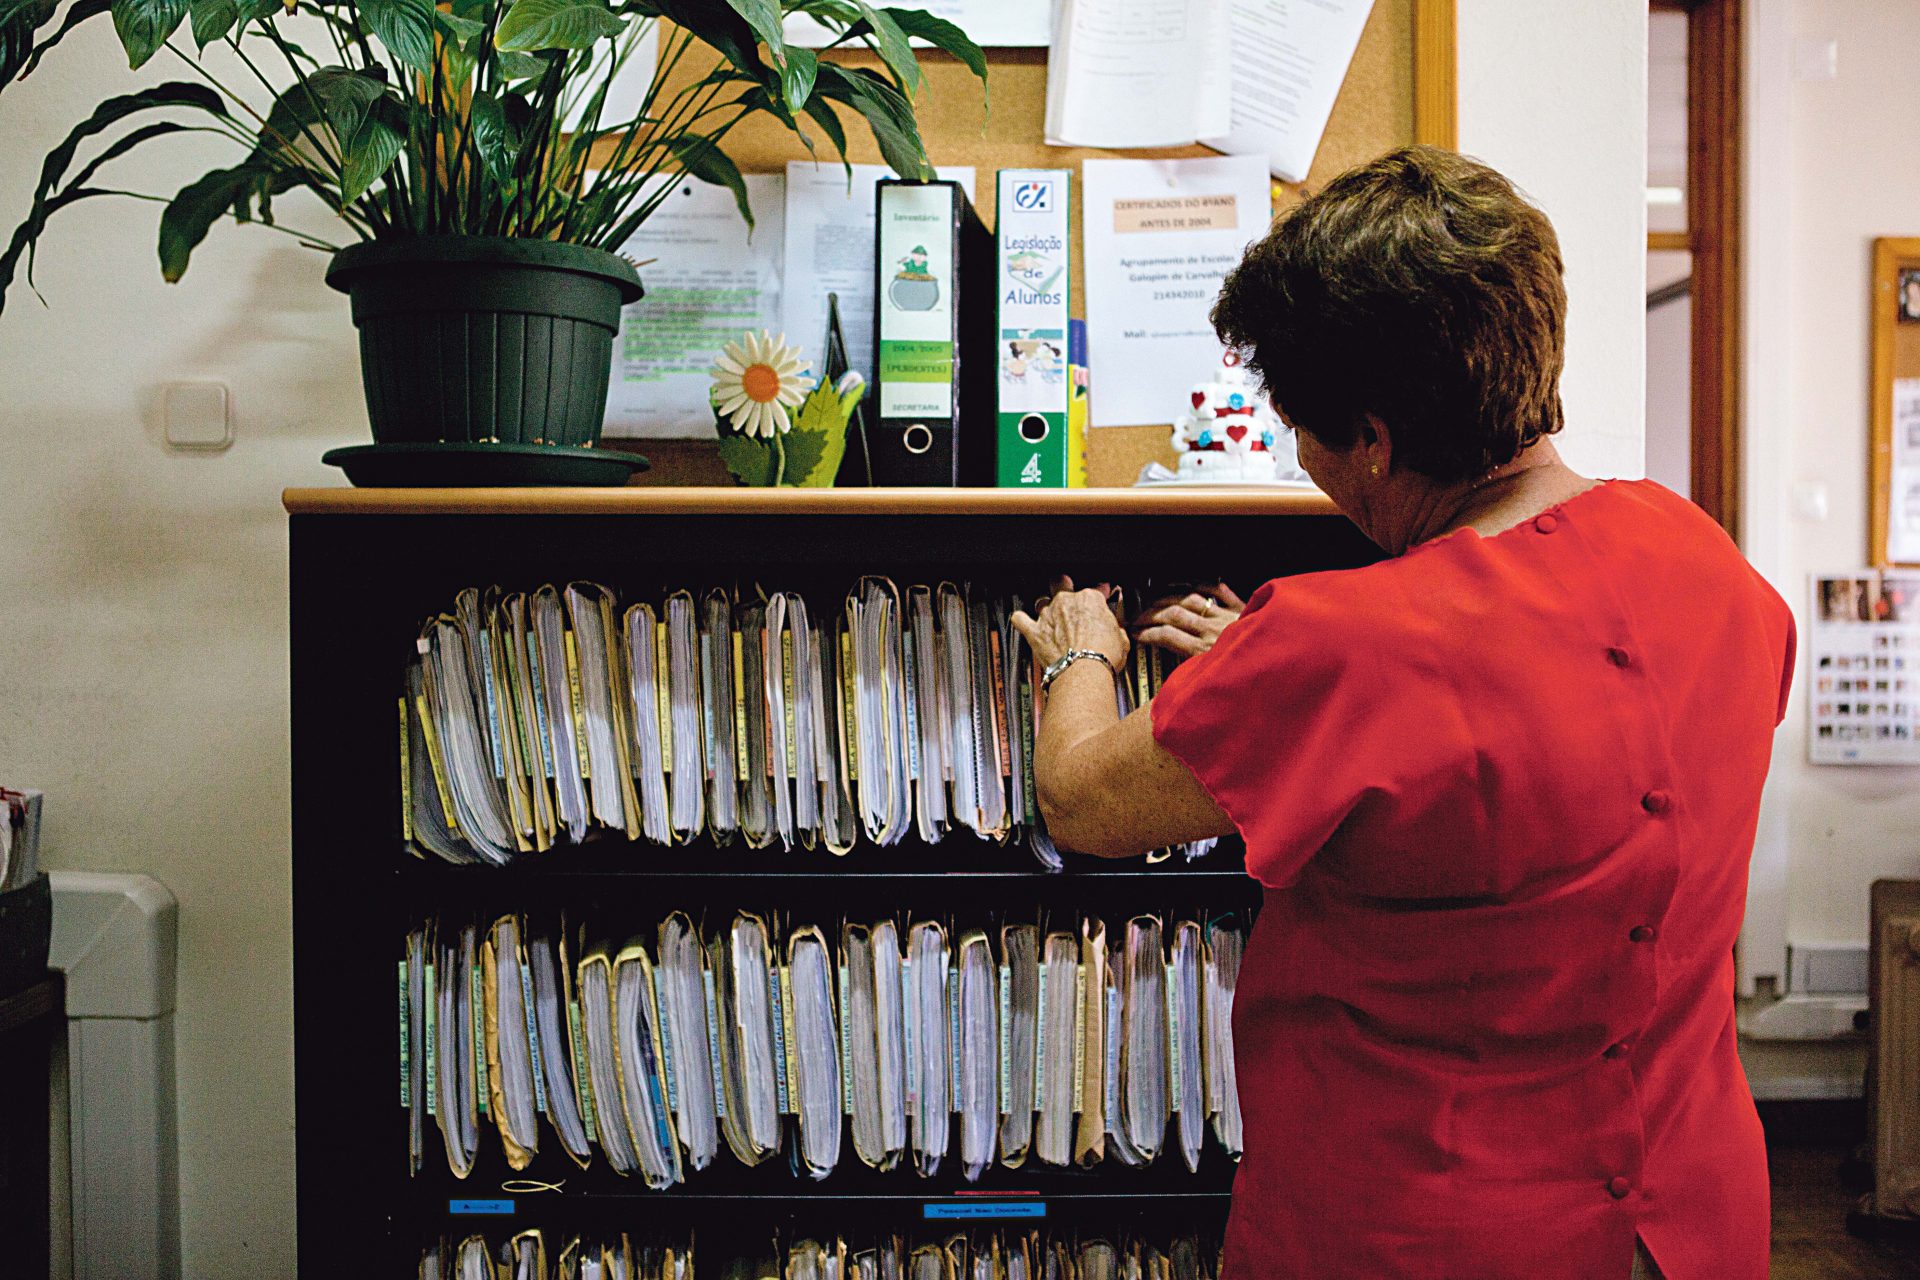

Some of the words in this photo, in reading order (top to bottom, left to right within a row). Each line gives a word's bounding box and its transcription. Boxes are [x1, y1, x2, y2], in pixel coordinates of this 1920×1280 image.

[1115, 199, 1182, 210] CERTIFICADOS
[1185, 199, 1199, 208] DO
[1140, 219, 1170, 228] ANTES
[1174, 218, 1184, 227] DE
[1005, 234, 1062, 251] Legislação
[1120, 256, 1184, 268] Agrupamento
[1187, 255, 1198, 264] de
[1201, 254, 1235, 264] Escolas
[1023, 266, 1044, 279] de
[1171, 272, 1182, 281] de
[1004, 290, 1062, 305] Alunos
[1020, 452, 1042, 483] 4
